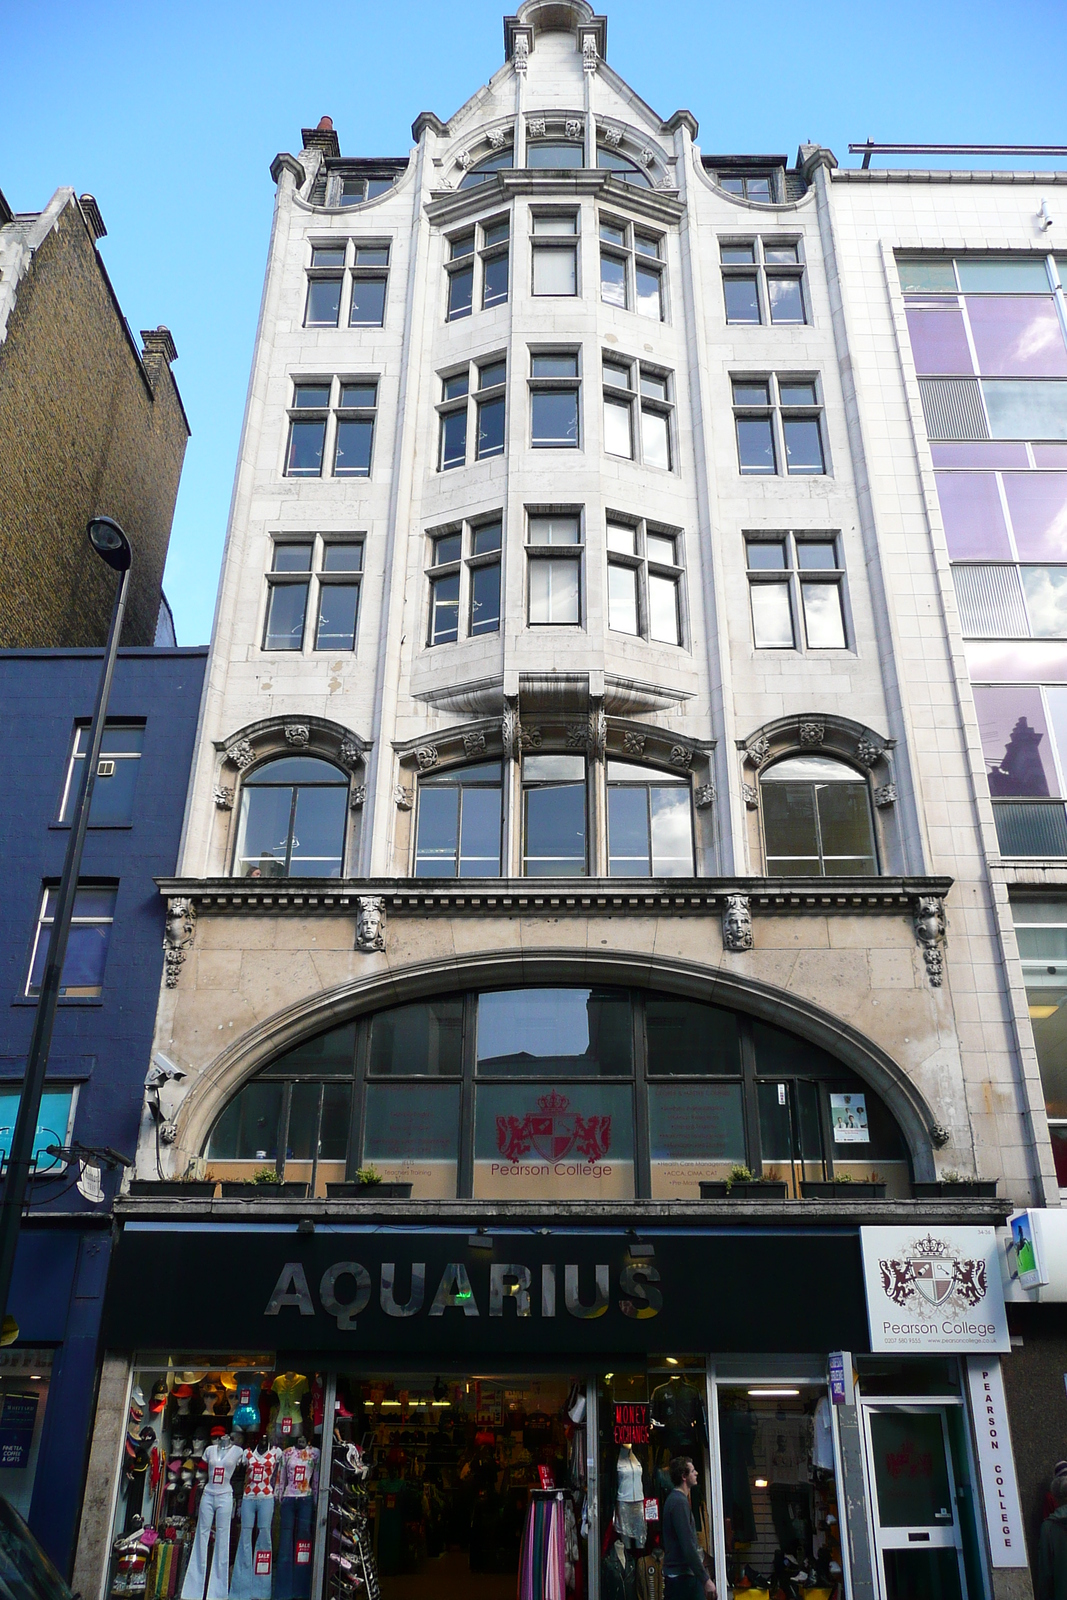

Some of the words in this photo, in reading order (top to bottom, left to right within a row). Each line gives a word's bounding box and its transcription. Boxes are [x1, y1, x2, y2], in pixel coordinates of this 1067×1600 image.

[491, 1163, 550, 1175] Pearson
[554, 1163, 612, 1178] College
[263, 1261, 663, 1331] AQUARIUS
[883, 1321, 938, 1334] Pearson
[942, 1321, 996, 1337] College
[616, 1405, 646, 1424] MONEY
[614, 1425, 650, 1444] EXCHANGE
[982, 1371, 999, 1449] PEARSON
[994, 1465, 1012, 1547] COLLEGE
